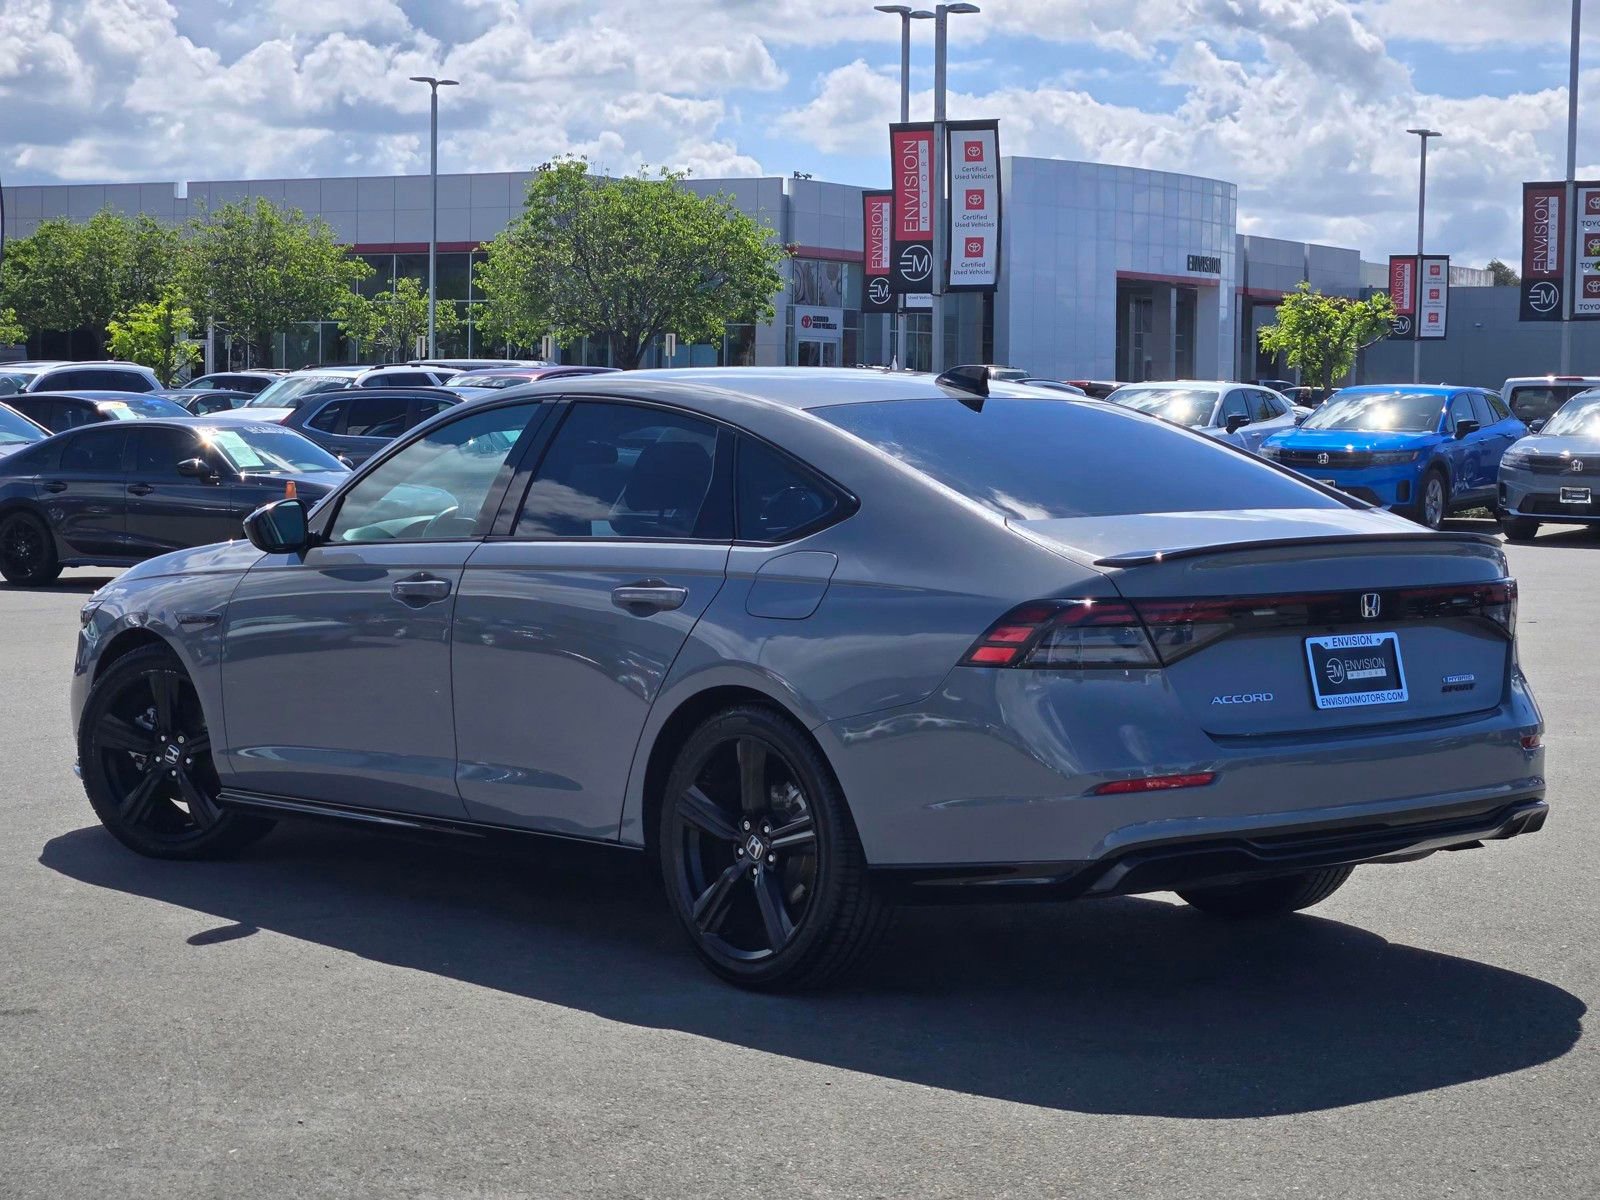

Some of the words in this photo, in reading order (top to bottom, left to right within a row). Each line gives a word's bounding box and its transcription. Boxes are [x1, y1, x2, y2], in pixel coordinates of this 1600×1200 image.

[903, 140, 919, 232] ENVISION
[871, 202, 883, 269] ENVISION
[1533, 196, 1548, 271] ENVISION
[1187, 254, 1221, 274] ENVISION
[1396, 263, 1404, 310] ENVISION
[1332, 635, 1373, 647] ENVISION
[1344, 658, 1385, 670] ENVISION
[1211, 692, 1274, 705] ACCORD
[1321, 691, 1404, 707] ENVISIONMOTORS.COM
